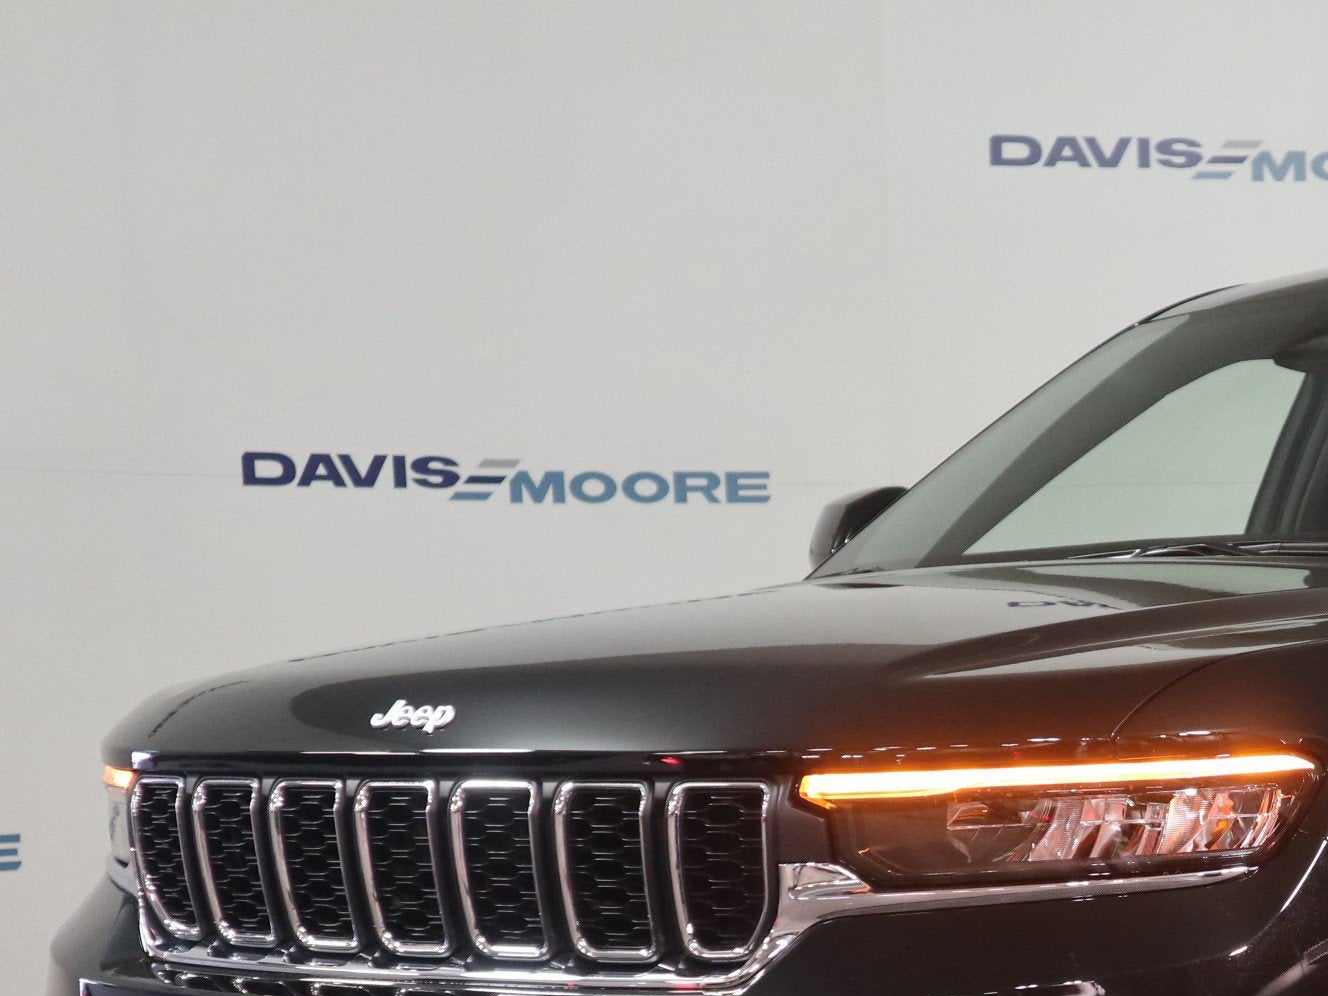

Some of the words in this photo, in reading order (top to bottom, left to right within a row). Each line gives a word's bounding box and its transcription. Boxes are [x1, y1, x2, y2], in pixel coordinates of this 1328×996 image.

[988, 133, 1204, 169] DAVIS
[241, 450, 461, 490] DAVIS
[509, 470, 771, 504] MOORE
[370, 699, 456, 734] Jeep
